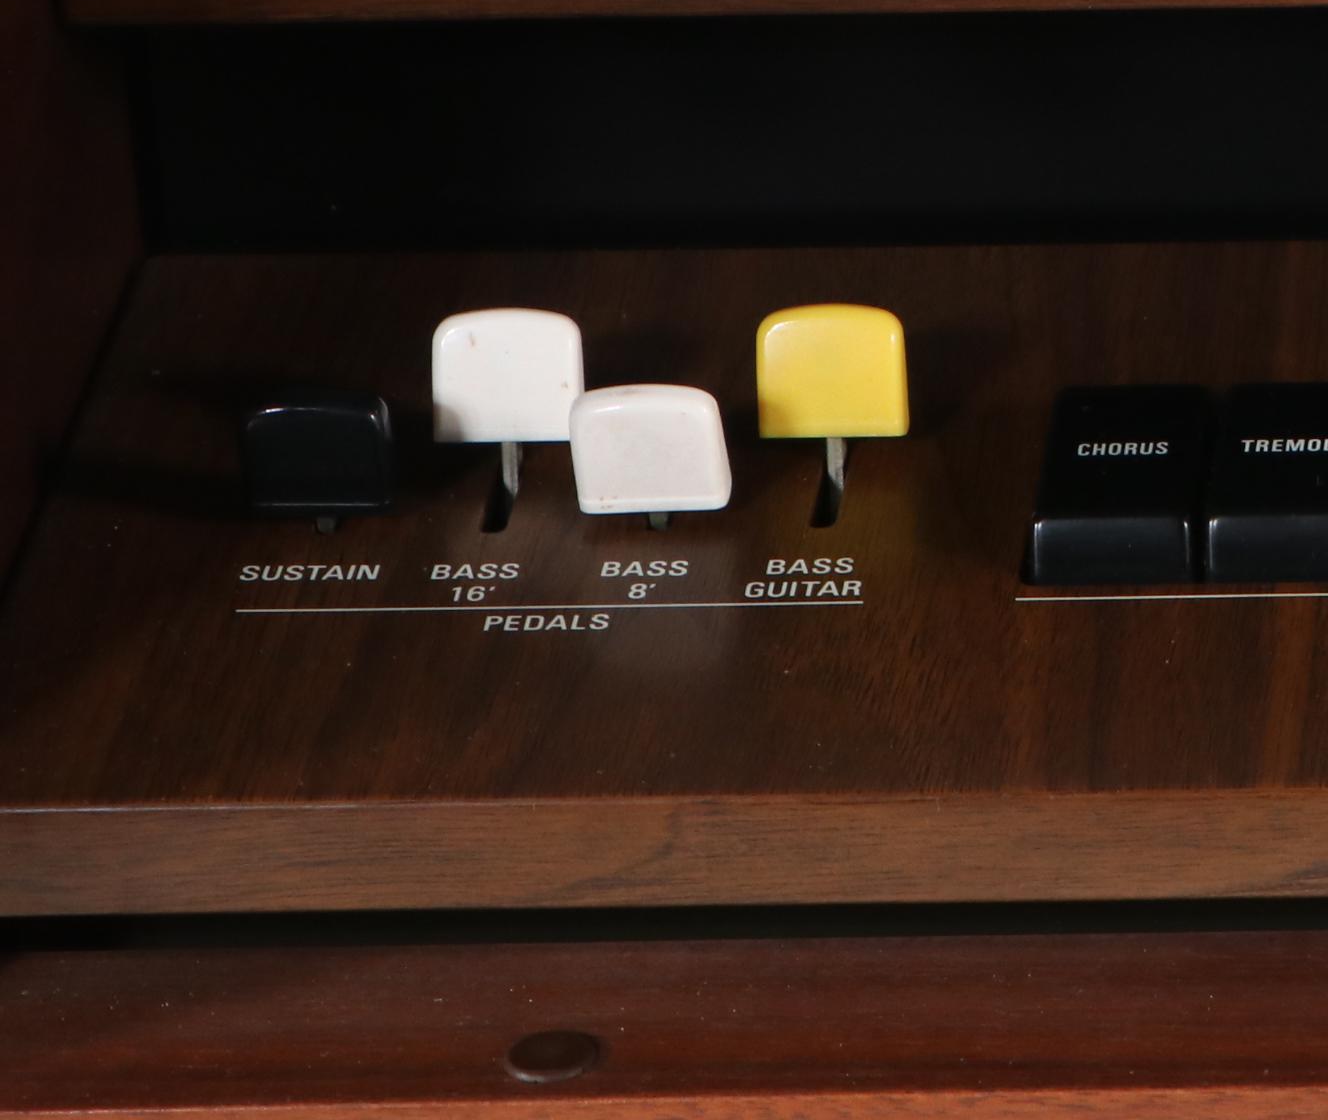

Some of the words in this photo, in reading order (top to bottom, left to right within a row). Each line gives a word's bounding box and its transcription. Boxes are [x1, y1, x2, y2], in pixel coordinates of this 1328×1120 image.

[1077, 441, 1169, 457] CHORUS
[239, 564, 380, 581] SUSTAIN
[430, 563, 520, 580] BASS
[600, 560, 689, 577] BASS
[766, 558, 855, 575] BASS
[744, 581, 862, 598] GUITAR
[483, 614, 611, 631] PEDALS
